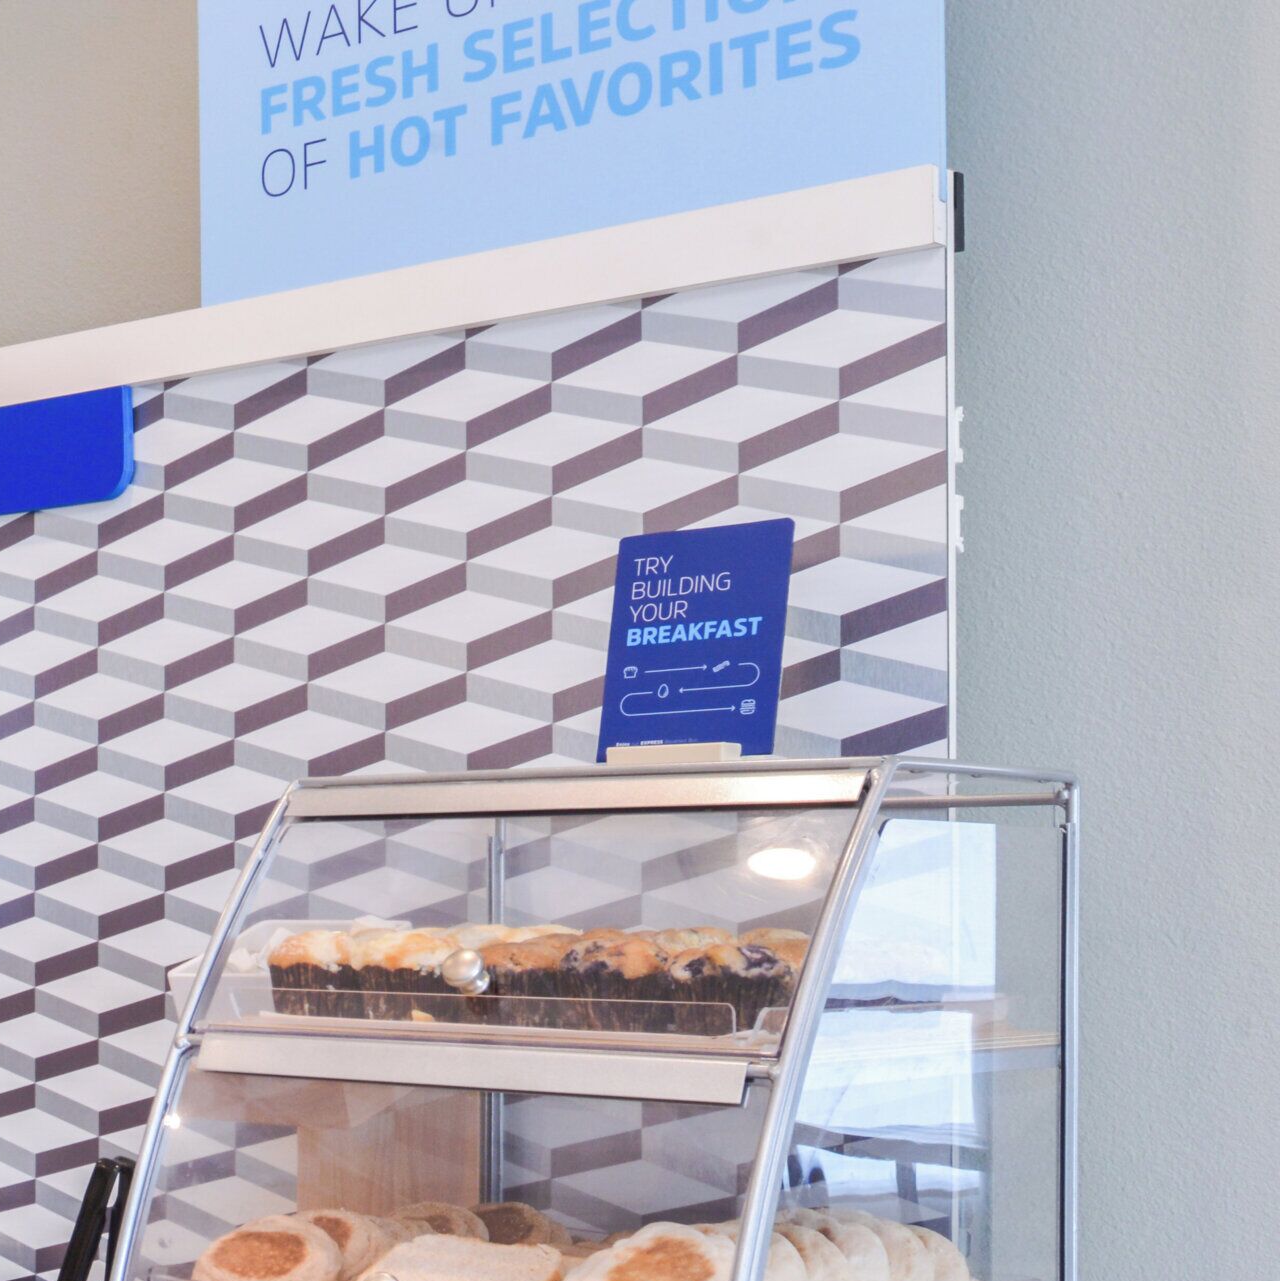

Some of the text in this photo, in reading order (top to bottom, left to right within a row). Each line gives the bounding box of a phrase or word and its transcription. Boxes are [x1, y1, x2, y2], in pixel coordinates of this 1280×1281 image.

[259, 0, 418, 68] WAKE
[260, 43, 439, 135] FRESH
[261, 10, 861, 198] OF HOT FAVORITES
[634, 555, 675, 577] TRY
[631, 572, 732, 601] BUILDING
[630, 599, 689, 624] YOUR
[626, 615, 764, 647] BREAKFAST
